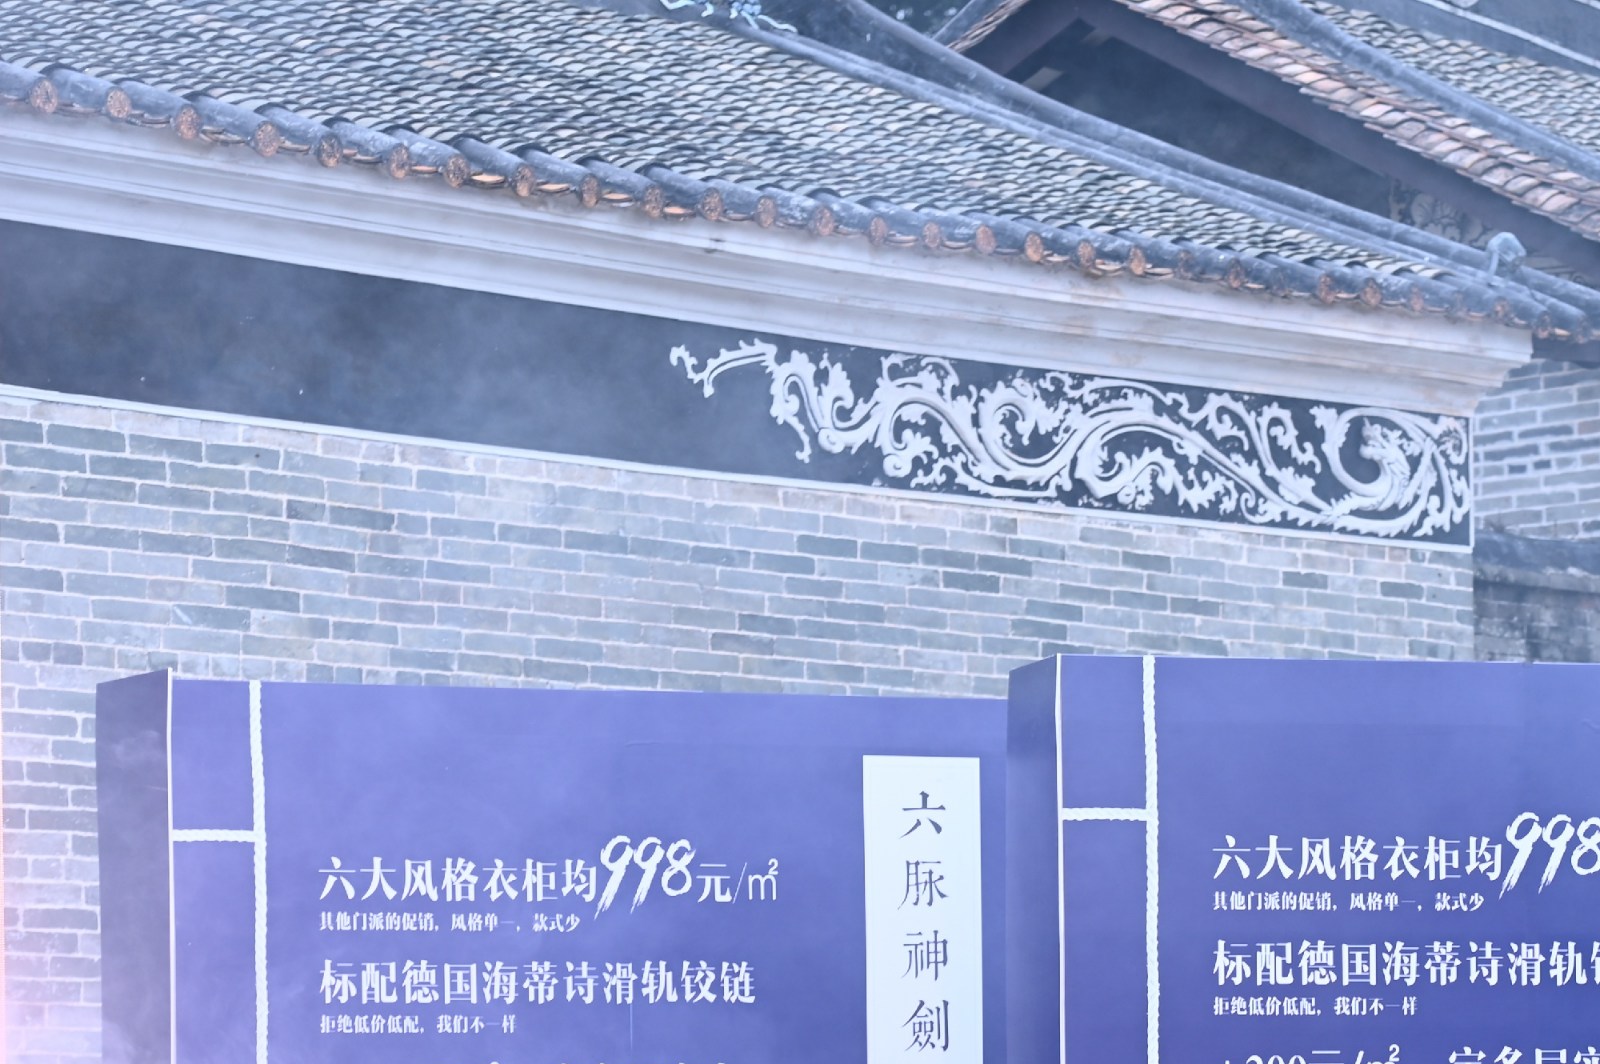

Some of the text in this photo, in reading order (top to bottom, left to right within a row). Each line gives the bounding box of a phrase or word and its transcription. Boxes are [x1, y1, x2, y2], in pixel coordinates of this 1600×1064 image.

[320, 959, 755, 1004] 标配德国海蒂诗滑轨铰链
